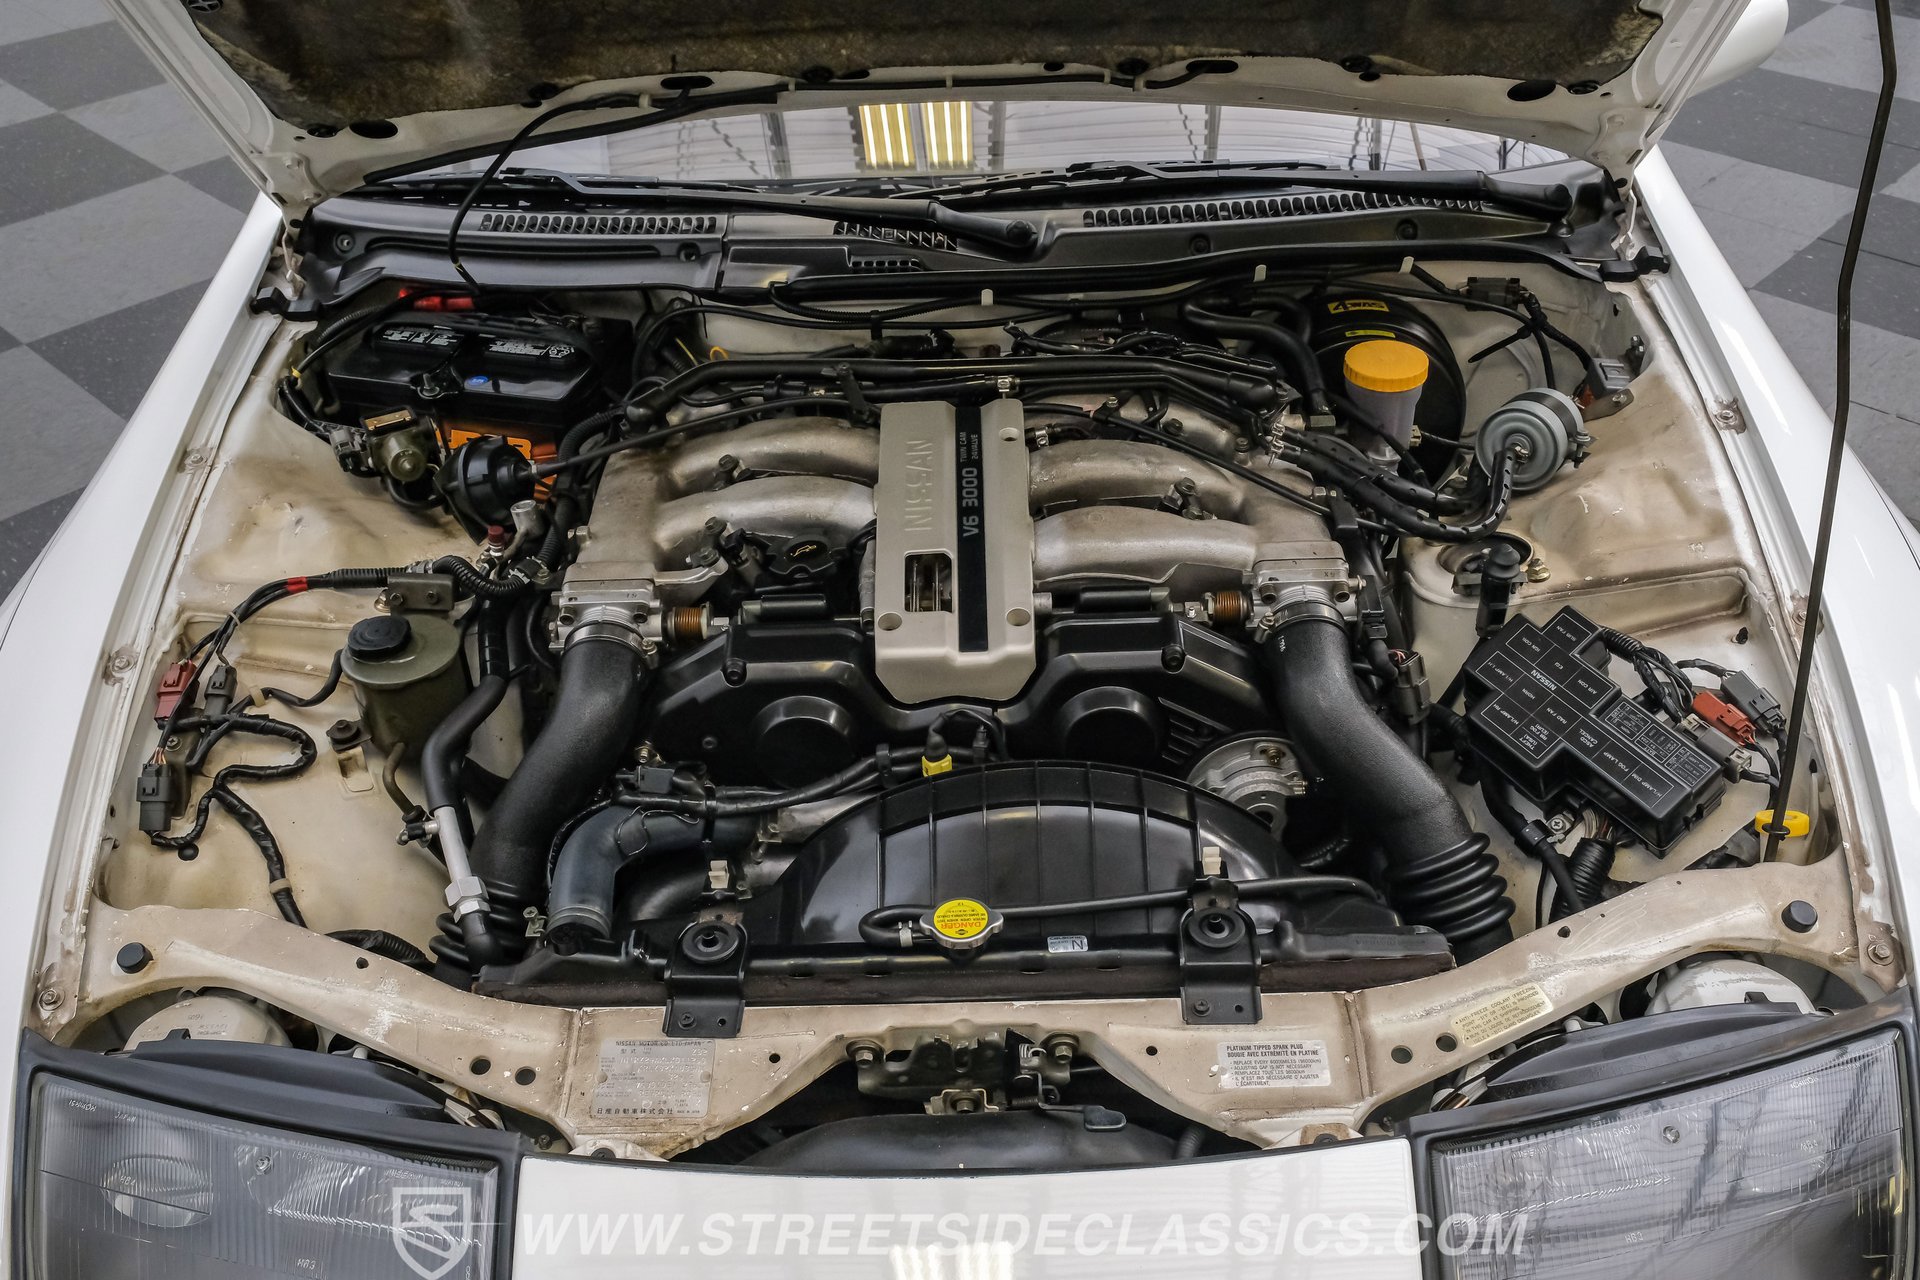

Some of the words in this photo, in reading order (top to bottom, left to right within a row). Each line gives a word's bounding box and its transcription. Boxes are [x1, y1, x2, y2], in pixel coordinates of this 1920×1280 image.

[960, 447, 968, 462] TWIN
[904, 440, 933, 531] NISSAN
[962, 467, 978, 507] 3000
[962, 515, 979, 537] V6
[1530, 669, 1558, 691] NISSAN
[1522, 688, 1536, 700] HORN
[1588, 686, 1597, 695] AIR
[1500, 710, 1519, 725] H/LAMP
[1546, 708, 1557, 717] FAN
[1556, 715, 1567, 724] RAD
[1579, 729, 1598, 744] CANCEL
[1580, 736, 1594, 748] ASCD
[1519, 737, 1535, 751] THEFT
[1603, 751, 1619, 764] LAMP
[1618, 762, 1630, 772] FOG
[1631, 773, 1642, 782] DIM
[1641, 781, 1663, 798] H/LAMP
[1071, 939, 1083, 950] N
[1491, 996, 1511, 1008] COOLANT
